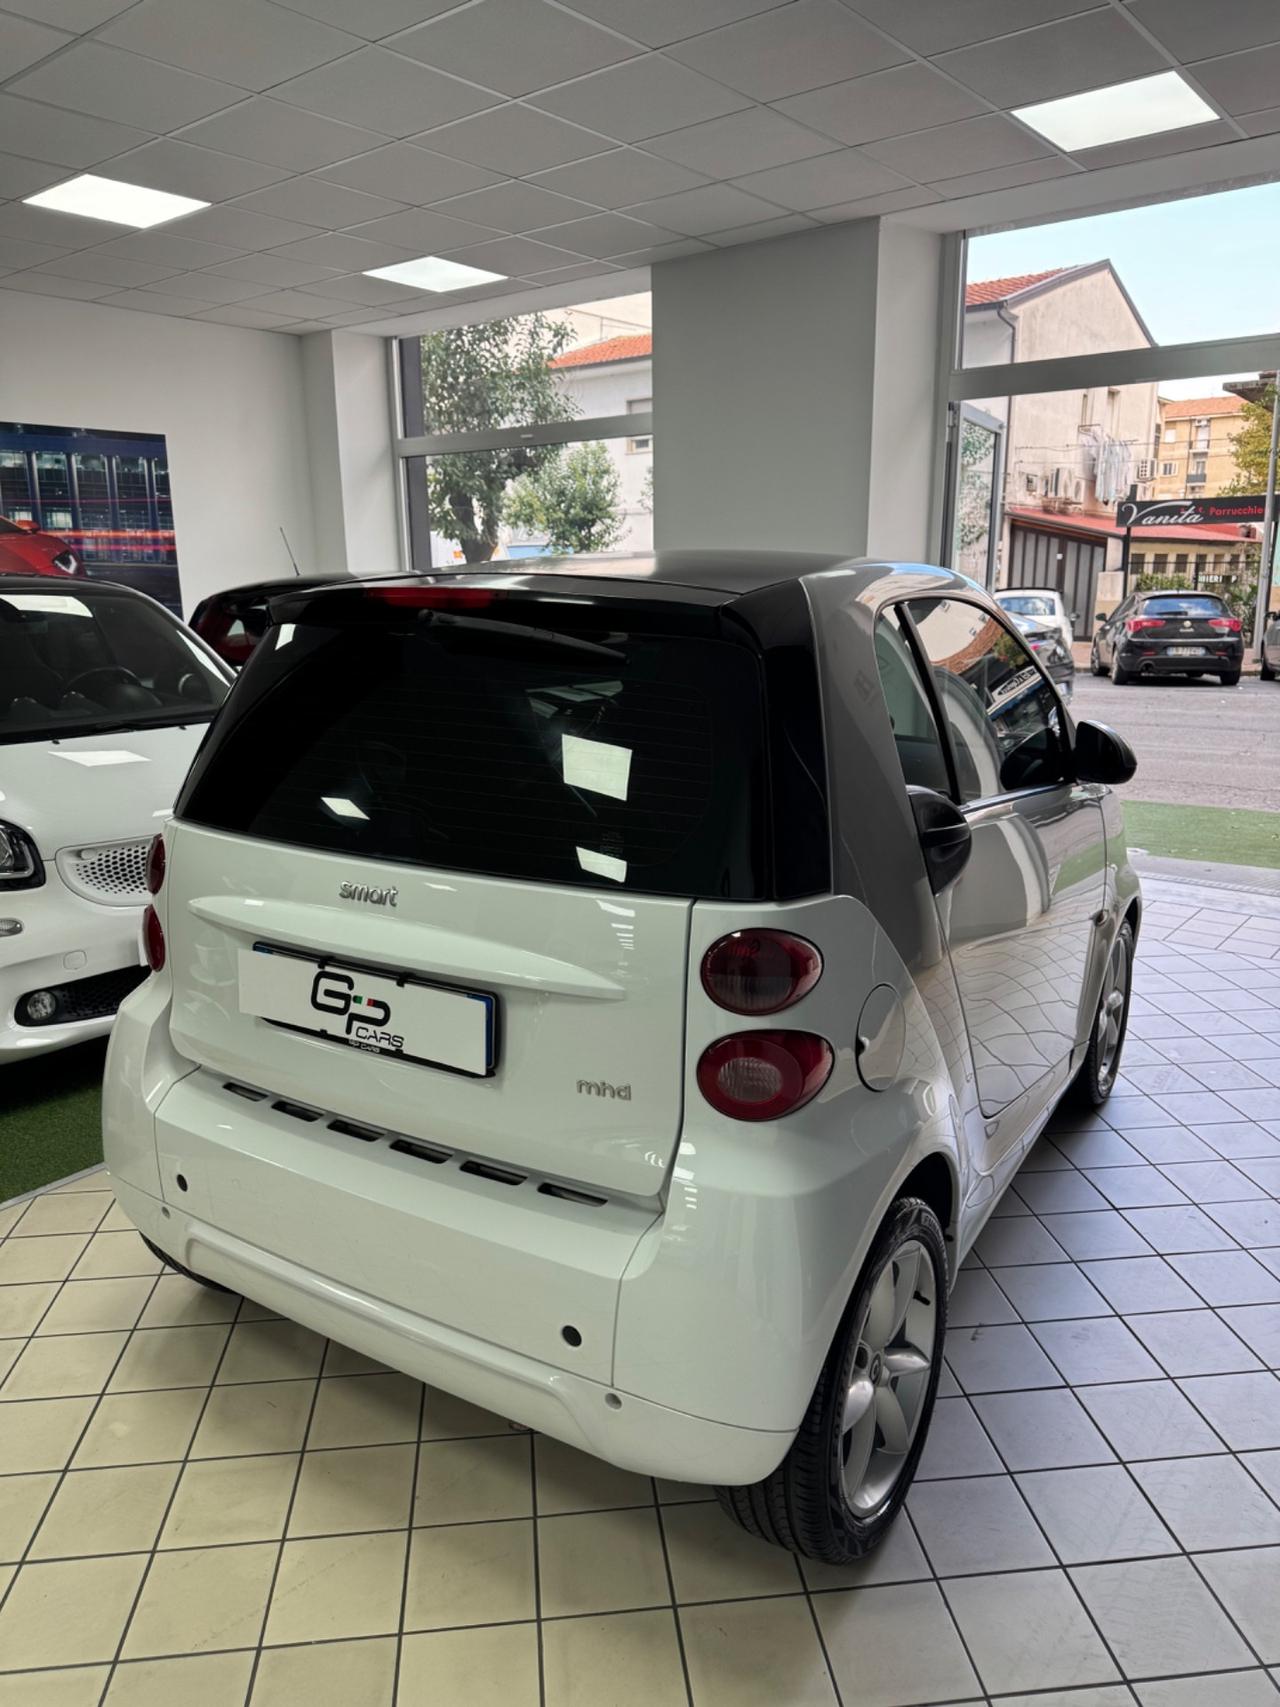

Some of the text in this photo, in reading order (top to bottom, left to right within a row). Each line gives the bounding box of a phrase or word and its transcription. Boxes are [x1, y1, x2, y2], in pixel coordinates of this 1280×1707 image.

[1209, 506, 1265, 517] Parrucchie
[339, 881, 398, 907] smart
[356, 1026, 405, 1048] CARS
[576, 1079, 631, 1101] mhd
